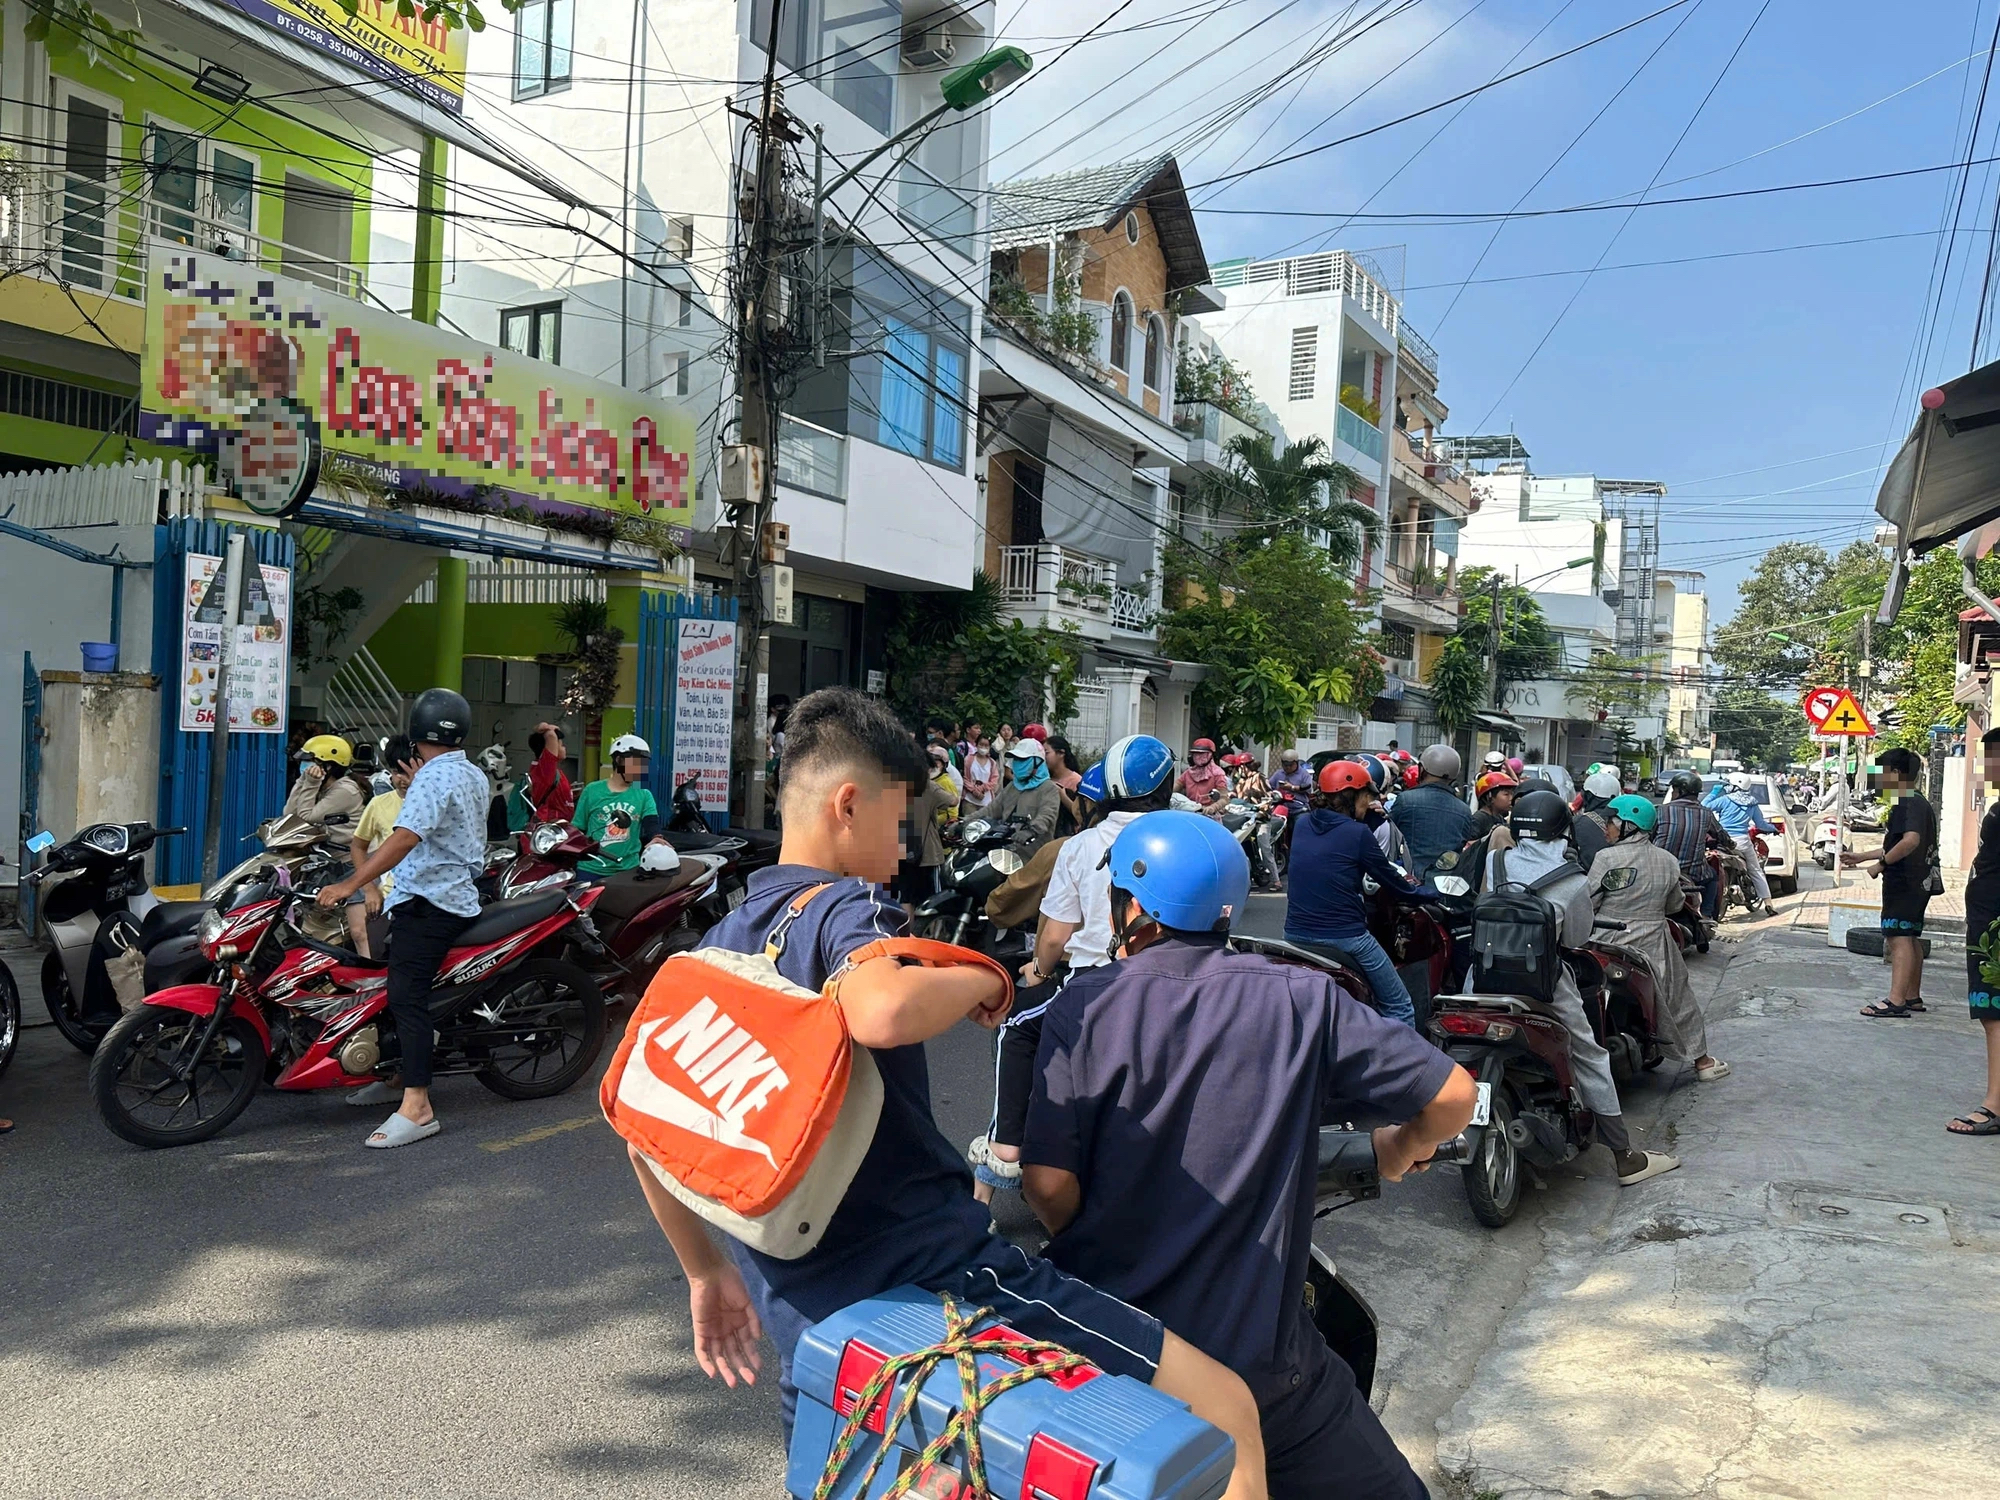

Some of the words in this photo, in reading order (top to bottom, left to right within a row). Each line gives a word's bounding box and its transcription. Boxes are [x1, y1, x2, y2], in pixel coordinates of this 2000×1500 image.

[277, 14, 295, 31] ĐT:
[297, 24, 326, 46] 0258.
[602, 801, 636, 814] STATE
[453, 958, 498, 985] SUZUKI
[1524, 1018, 1553, 1029] VISION
[653, 995, 791, 1134] NIKE
